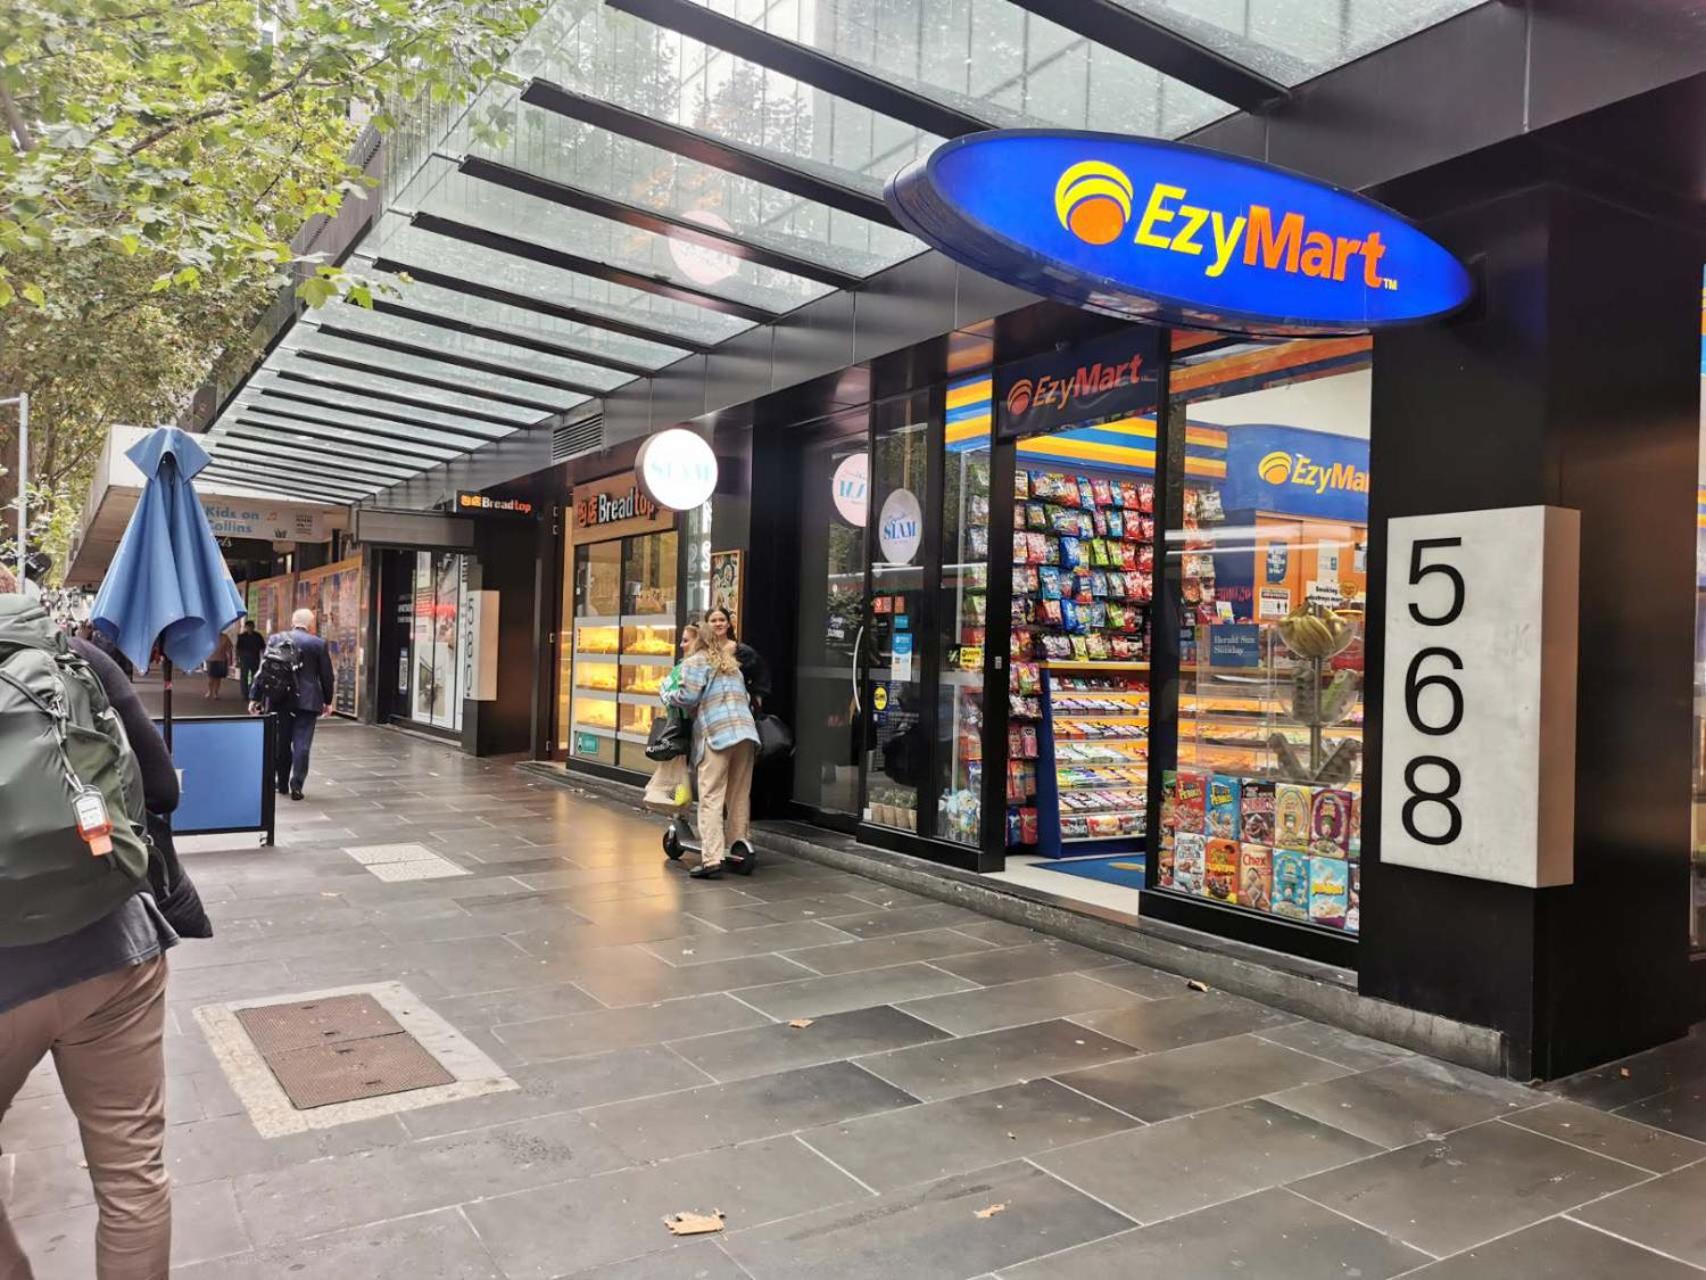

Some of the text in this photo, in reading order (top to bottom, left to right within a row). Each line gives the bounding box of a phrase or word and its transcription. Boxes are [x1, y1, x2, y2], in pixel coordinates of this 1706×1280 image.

[1134, 182, 1386, 288] EzyMart
[1032, 353, 1143, 410] EzyMart
[206, 506, 259, 520] Kids on
[884, 521, 916, 539] SIAM
[1400, 537, 1466, 846] 568
